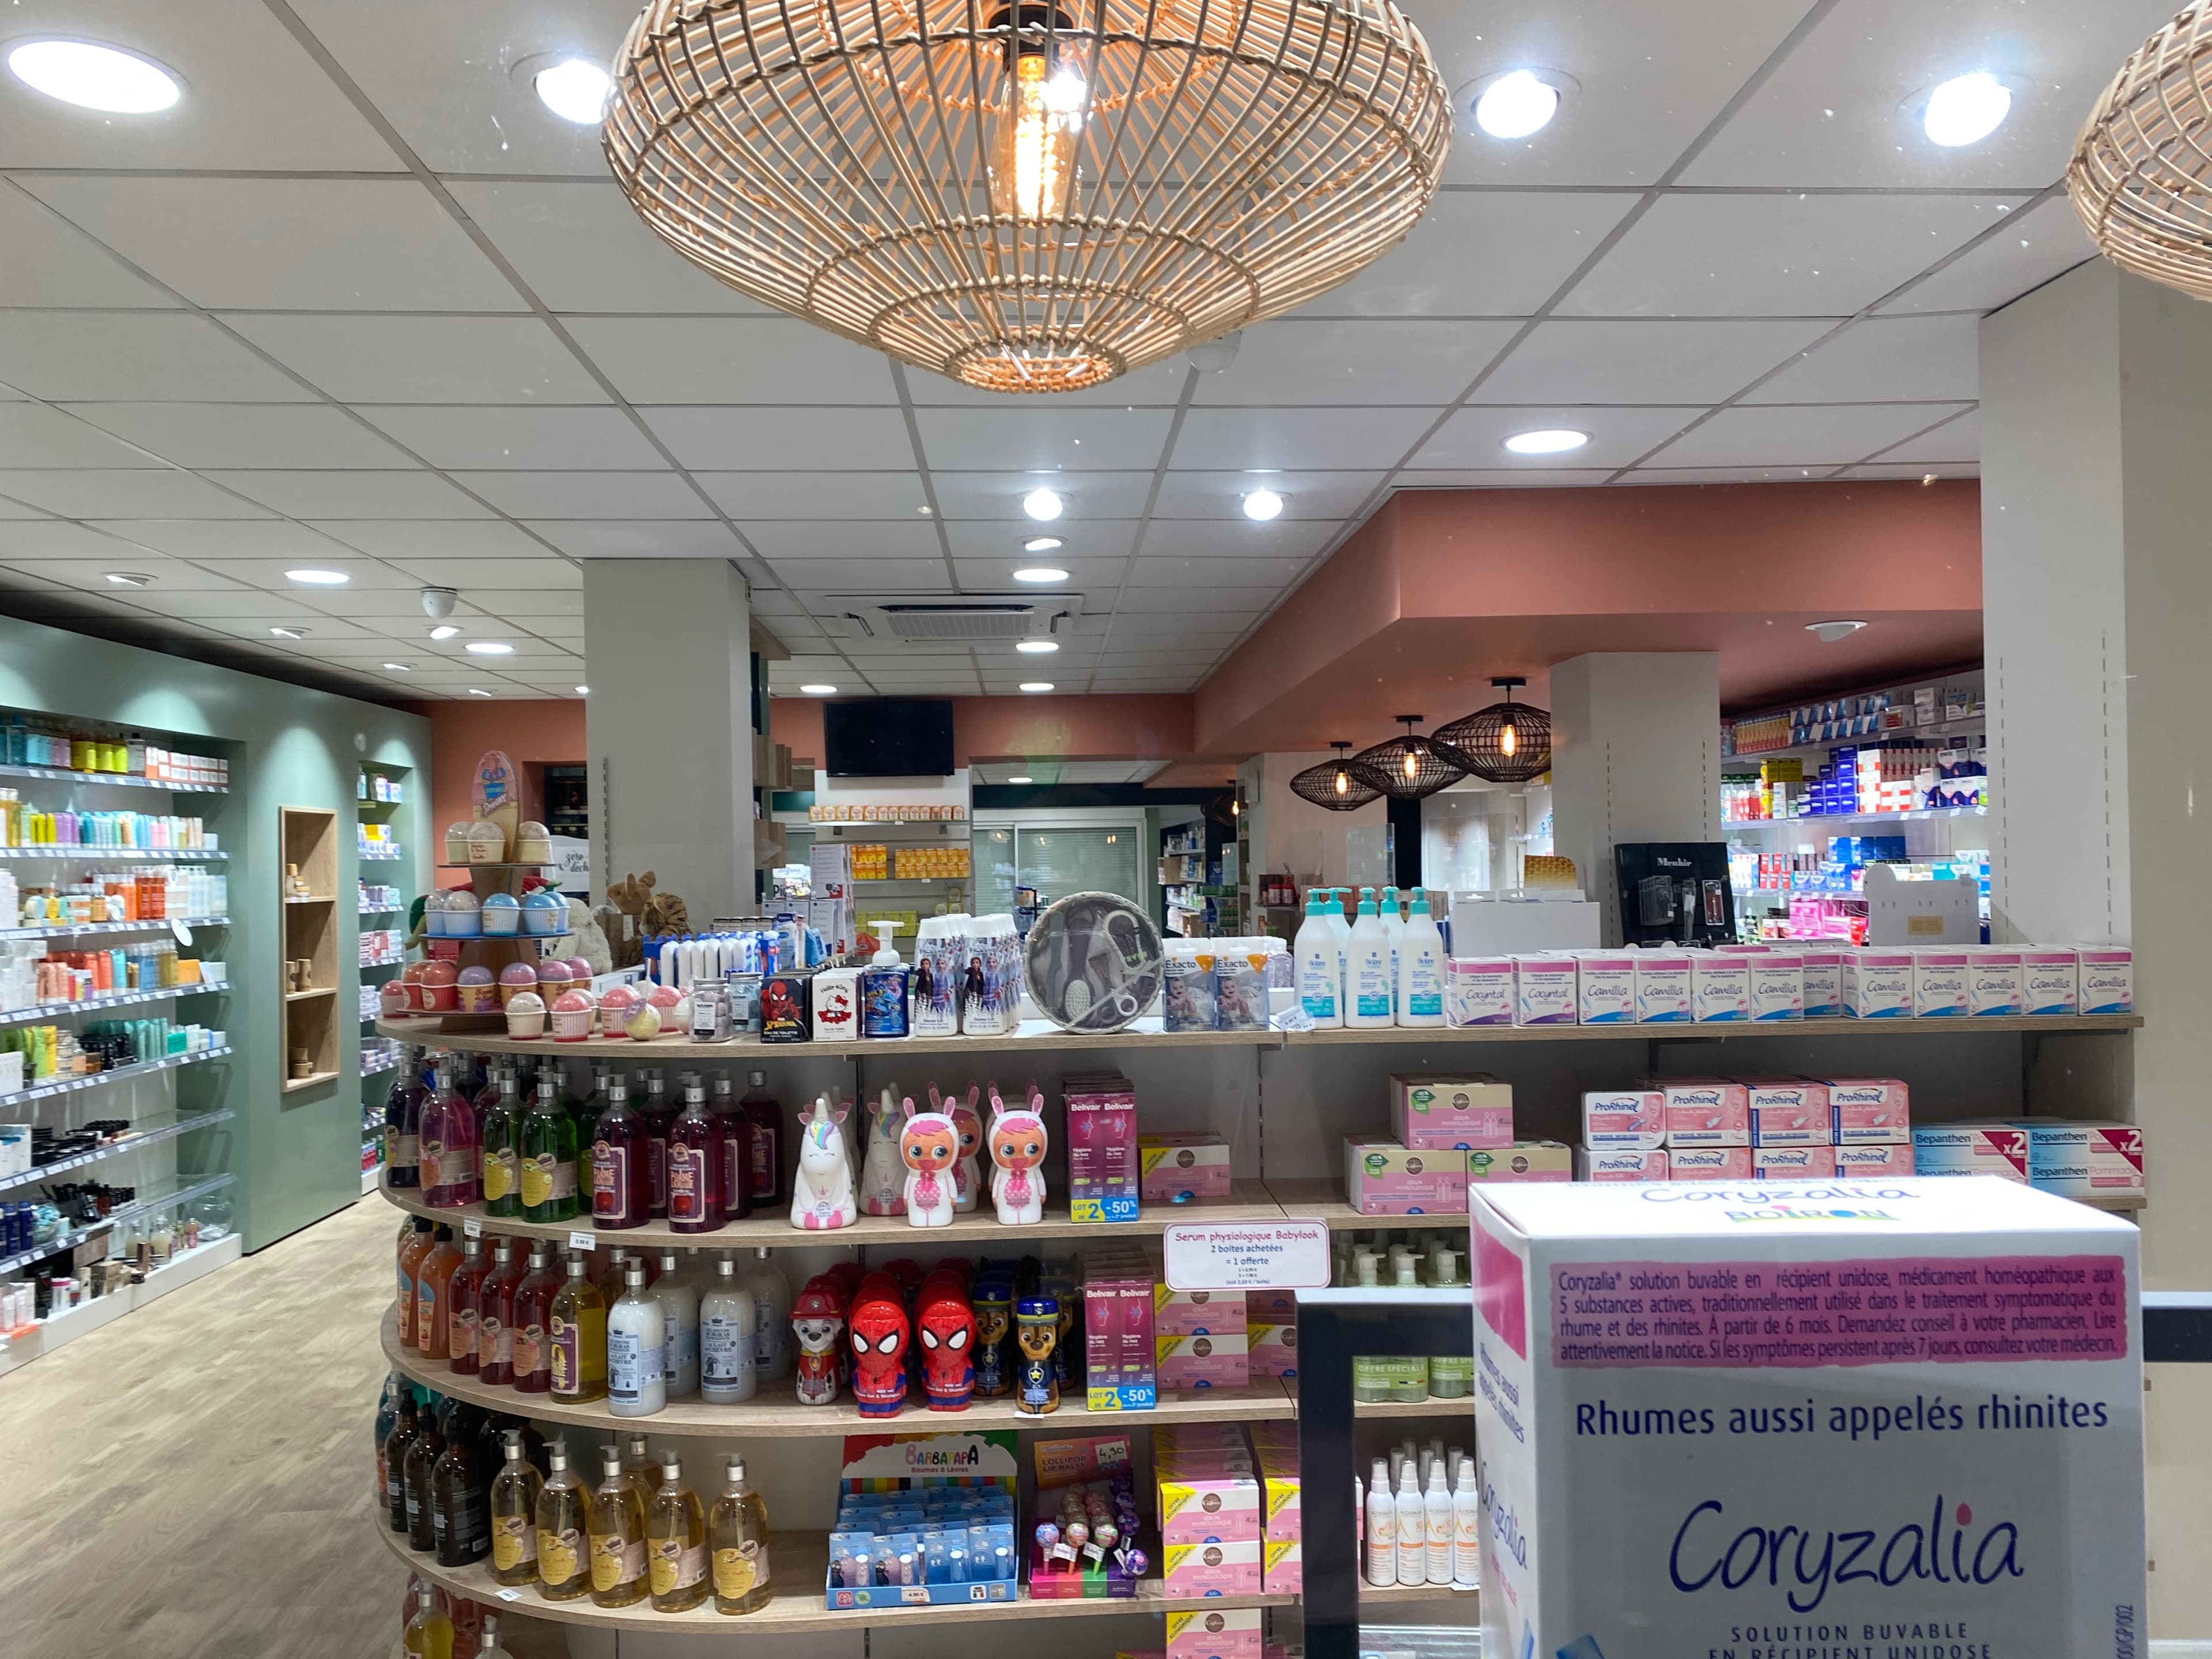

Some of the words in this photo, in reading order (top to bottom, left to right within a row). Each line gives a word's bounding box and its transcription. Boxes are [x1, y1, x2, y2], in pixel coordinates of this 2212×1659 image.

[1166, 960, 1196, 969] Exacto
[1217, 959, 1248, 968] Exacto
[1588, 984, 1628, 997] Camilia
[1643, 984, 1684, 997] Camilia
[1703, 983, 1743, 997] Camilia
[1758, 982, 1797, 996] Camilia
[1803, 979, 1835, 990] amilia
[1673, 1093, 1721, 1105] ProRhinel
[1755, 1093, 1802, 1105] ProRhinel
[1836, 1090, 1883, 1103] ProRhinel
[1104, 1103, 1135, 1111] Belivair
[1594, 1100, 1639, 1112] ProRhinel
[1916, 1133, 1971, 1145] Bepanthen
[2002, 1132, 2026, 1155] x2
[2032, 1131, 2088, 1143] Bepanthen
[2119, 1130, 2143, 1153] x2
[1599, 1157, 1643, 1171] ProRhinel
[1677, 1152, 1724, 1166] ProRhinel
[1762, 1152, 1807, 1166] ProRhinel
[1841, 1151, 1889, 1164] ProRhinel
[2032, 1166, 2088, 1177] Bepanthen
[1641, 1185, 1922, 1204] Coryzalia
[1724, 1205, 1892, 1221] BOIRON
[1175, 1232, 1206, 1241] Serum
[1210, 1231, 1271, 1243] physiologique
[1276, 1230, 1318, 1241] Babylook
[1246, 1244, 1283, 1252] achetées
[1241, 1256, 1269, 1265] offerte
[1630, 1270, 1680, 1291] solution
[1688, 1269, 1738, 1290] buvable
[1745, 1274, 1761, 1289] en
[1776, 1268, 1831, 1292] récipient
[1838, 1268, 1892, 1289] unidose,
[1899, 1267, 1978, 1286] médicament
[1984, 1265, 2086, 1289] homéopathique
[2093, 1269, 2115, 1284] aux
[1086, 1290, 1117, 1298] Belivair
[1120, 1289, 1150, 1298] Belivair
[1559, 1297, 1568, 1315] 5
[1574, 1295, 1643, 1315] substances
[1649, 1295, 1696, 1315] actives,
[1702, 1293, 1819, 1313] traditionnellement
[1825, 1291, 1862, 1311] utilisé
[1868, 1291, 1898, 1310] dans
[1905, 1291, 1916, 1309] le
[1922, 1291, 1987, 1309] traitement
[1994, 1290, 2093, 1313] symptomatique
[2099, 1288, 2116, 1306] du
[1560, 1318, 1602, 1337] rhume
[1607, 1320, 1620, 1337] et
[1626, 1318, 1649, 1337] des
[1654, 1317, 1704, 1336] rhinites.
[1709, 1314, 1718, 1335] À
[1724, 1317, 1758, 1340] partir
[1763, 1316, 1780, 1335] de
[1786, 1317, 1794, 1335] 6
[1800, 1317, 1833, 1335] mois.
[1838, 1315, 1906, 1334] Demandez
[1911, 1313, 1955, 1332] conseil
[1960, 1313, 1968, 1332] à
[1973, 1314, 2005, 1332] votre
[2011, 1312, 2089, 1335] pharmacien.
[2093, 1310, 2116, 1330] Lire
[1560, 1342, 1650, 1361] attentivement
[1652, 1340, 1664, 1359] la
[1665, 1340, 1707, 1359] notice.
[1709, 1339, 1721, 1358] Si
[1723, 1339, 1740, 1358] les
[1743, 1338, 1815, 1363] symptômes
[1818, 1338, 1878, 1361] persistent
[1881, 1336, 1916, 1361] après
[1918, 1337, 1925, 1355] 7
[1927, 1336, 1963, 1359] jours,
[1964, 1335, 2024, 1355] consultez
[2027, 1335, 2058, 1353] votre
[2061, 1332, 2118, 1353] médecin.
[1359, 1364, 1385, 1372] OFFRE
[1104, 1391, 1116, 1407] 2
[1576, 1401, 1715, 1435] Rhumes
[1728, 1399, 1815, 1434] aussi
[1829, 1396, 1964, 1441] appelés
[1976, 1395, 2108, 1430] rhinites
[905, 1444, 979, 1465] BARBAPAPA
[1099, 1446, 1124, 1459] 4,90
[1042, 1456, 1086, 1465] LOLLIPOP
[1058, 1463, 1085, 1471] BALM
[1482, 1461, 1528, 1571] Coryzalia
[1669, 1494, 2025, 1613] Coryzalia
[1730, 1625, 1849, 1645] SOLUTION
[1863, 1622, 1968, 1640] BUVABLE
[1709, 1648, 1737, 1659] EN
[1752, 1643, 1875, 1659] RÉCIPIENT
[1888, 1643, 1991, 1659] UNIDOSE
